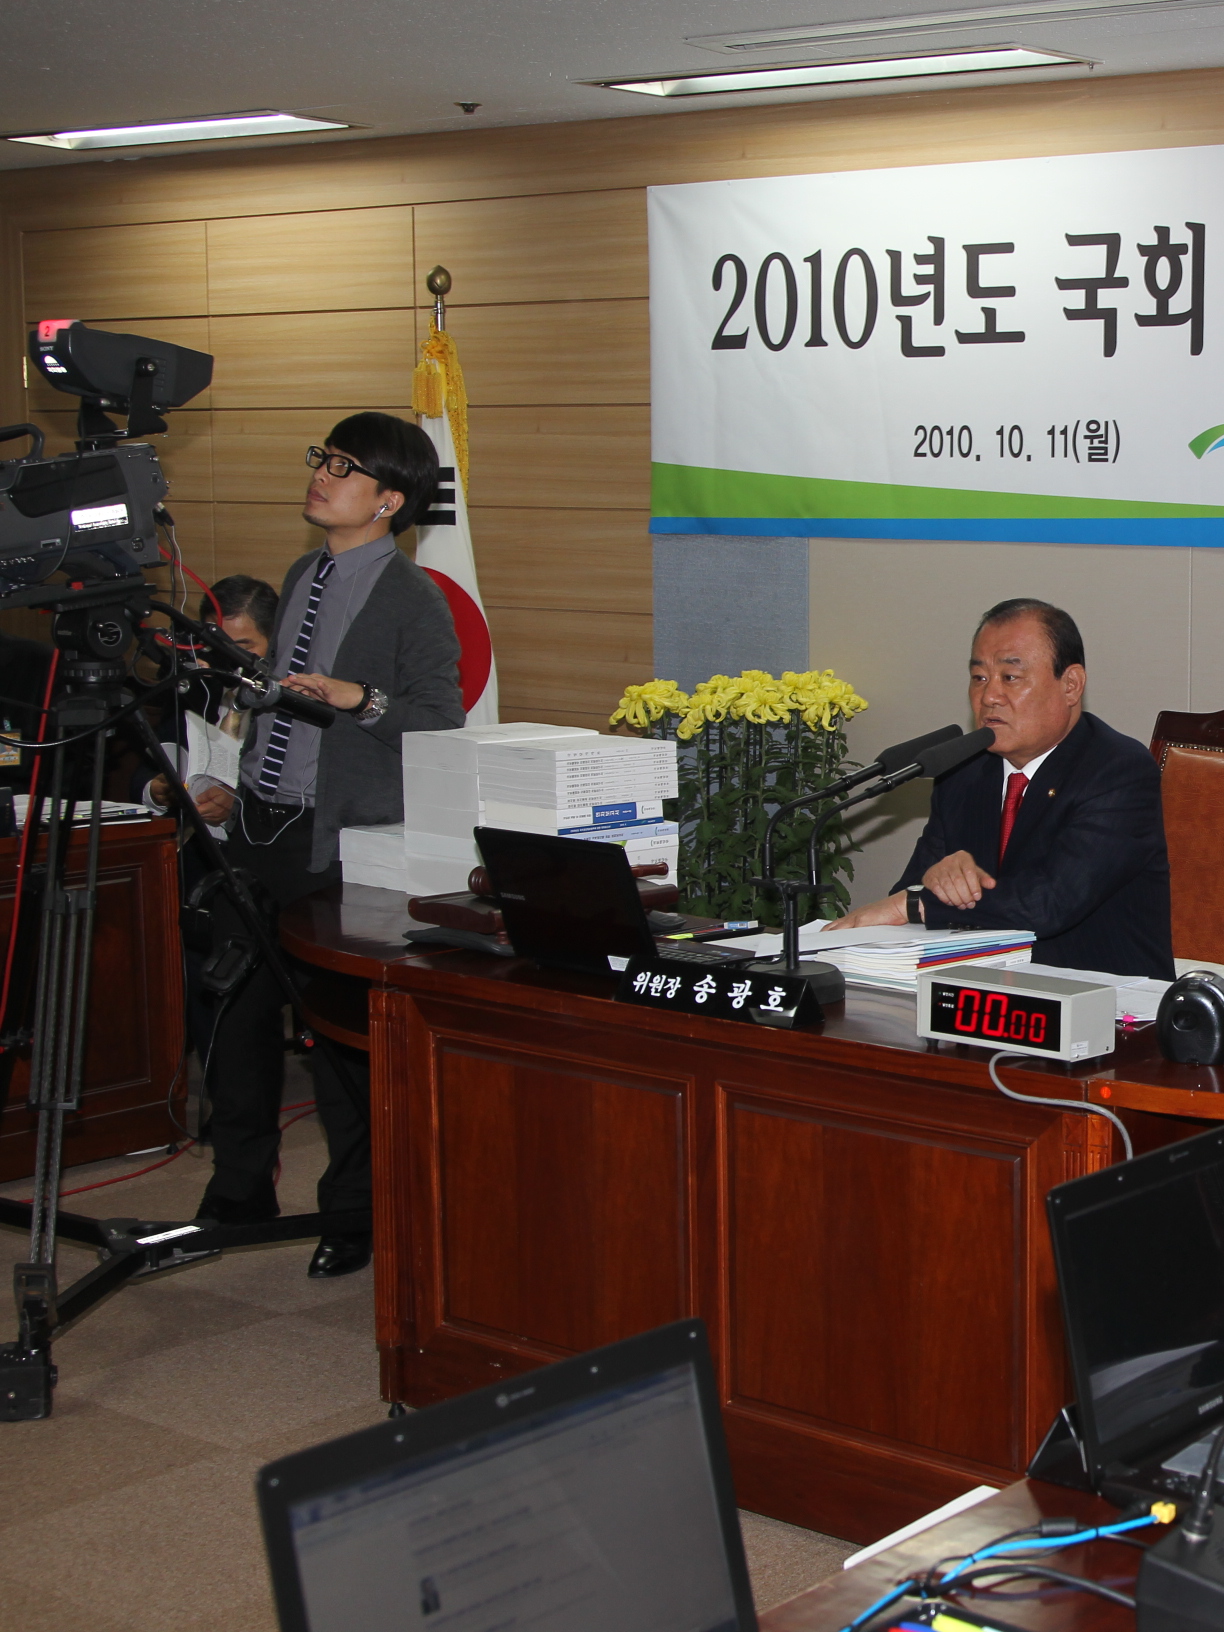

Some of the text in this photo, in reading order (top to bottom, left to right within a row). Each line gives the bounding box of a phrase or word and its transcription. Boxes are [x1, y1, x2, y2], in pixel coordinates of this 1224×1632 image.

[712, 236, 1025, 357] 2010년도
[1056, 222, 1205, 357] 국회
[45, 326, 50, 337] 2
[1048, 420, 1120, 463] 11(월)
[632, 971, 682, 999] 위원장
